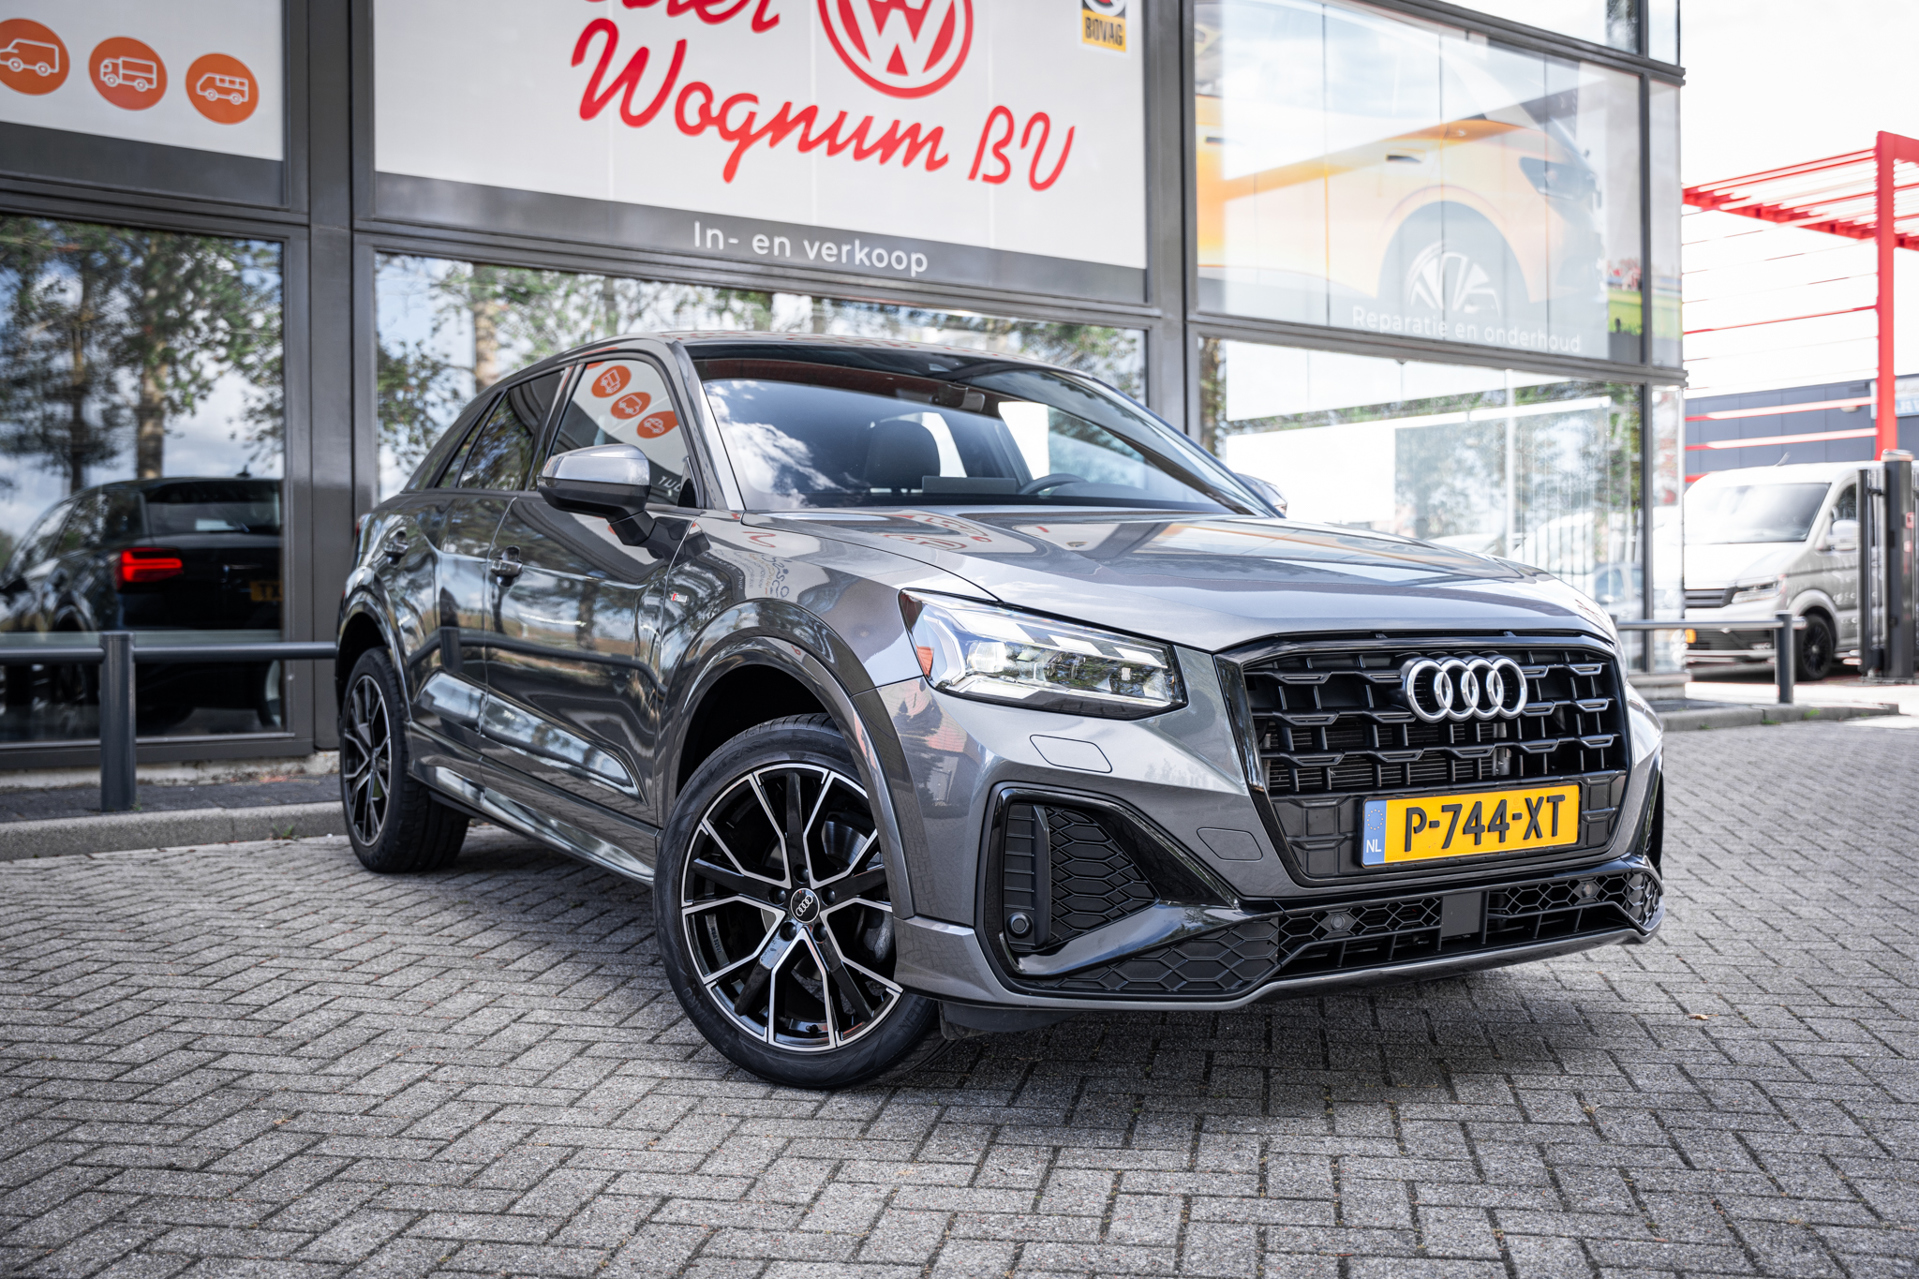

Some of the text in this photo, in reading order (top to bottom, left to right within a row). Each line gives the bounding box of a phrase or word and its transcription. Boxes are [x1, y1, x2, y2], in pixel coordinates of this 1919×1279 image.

[1085, 17, 1123, 46] BOVAG
[571, 18, 1075, 191] Wognum BV
[693, 221, 928, 277] In- en verkoop
[1352, 305, 1581, 353] Reparatie en onderhoud
[1366, 839, 1382, 853] NL
[1404, 794, 1566, 852] P-744-XT
